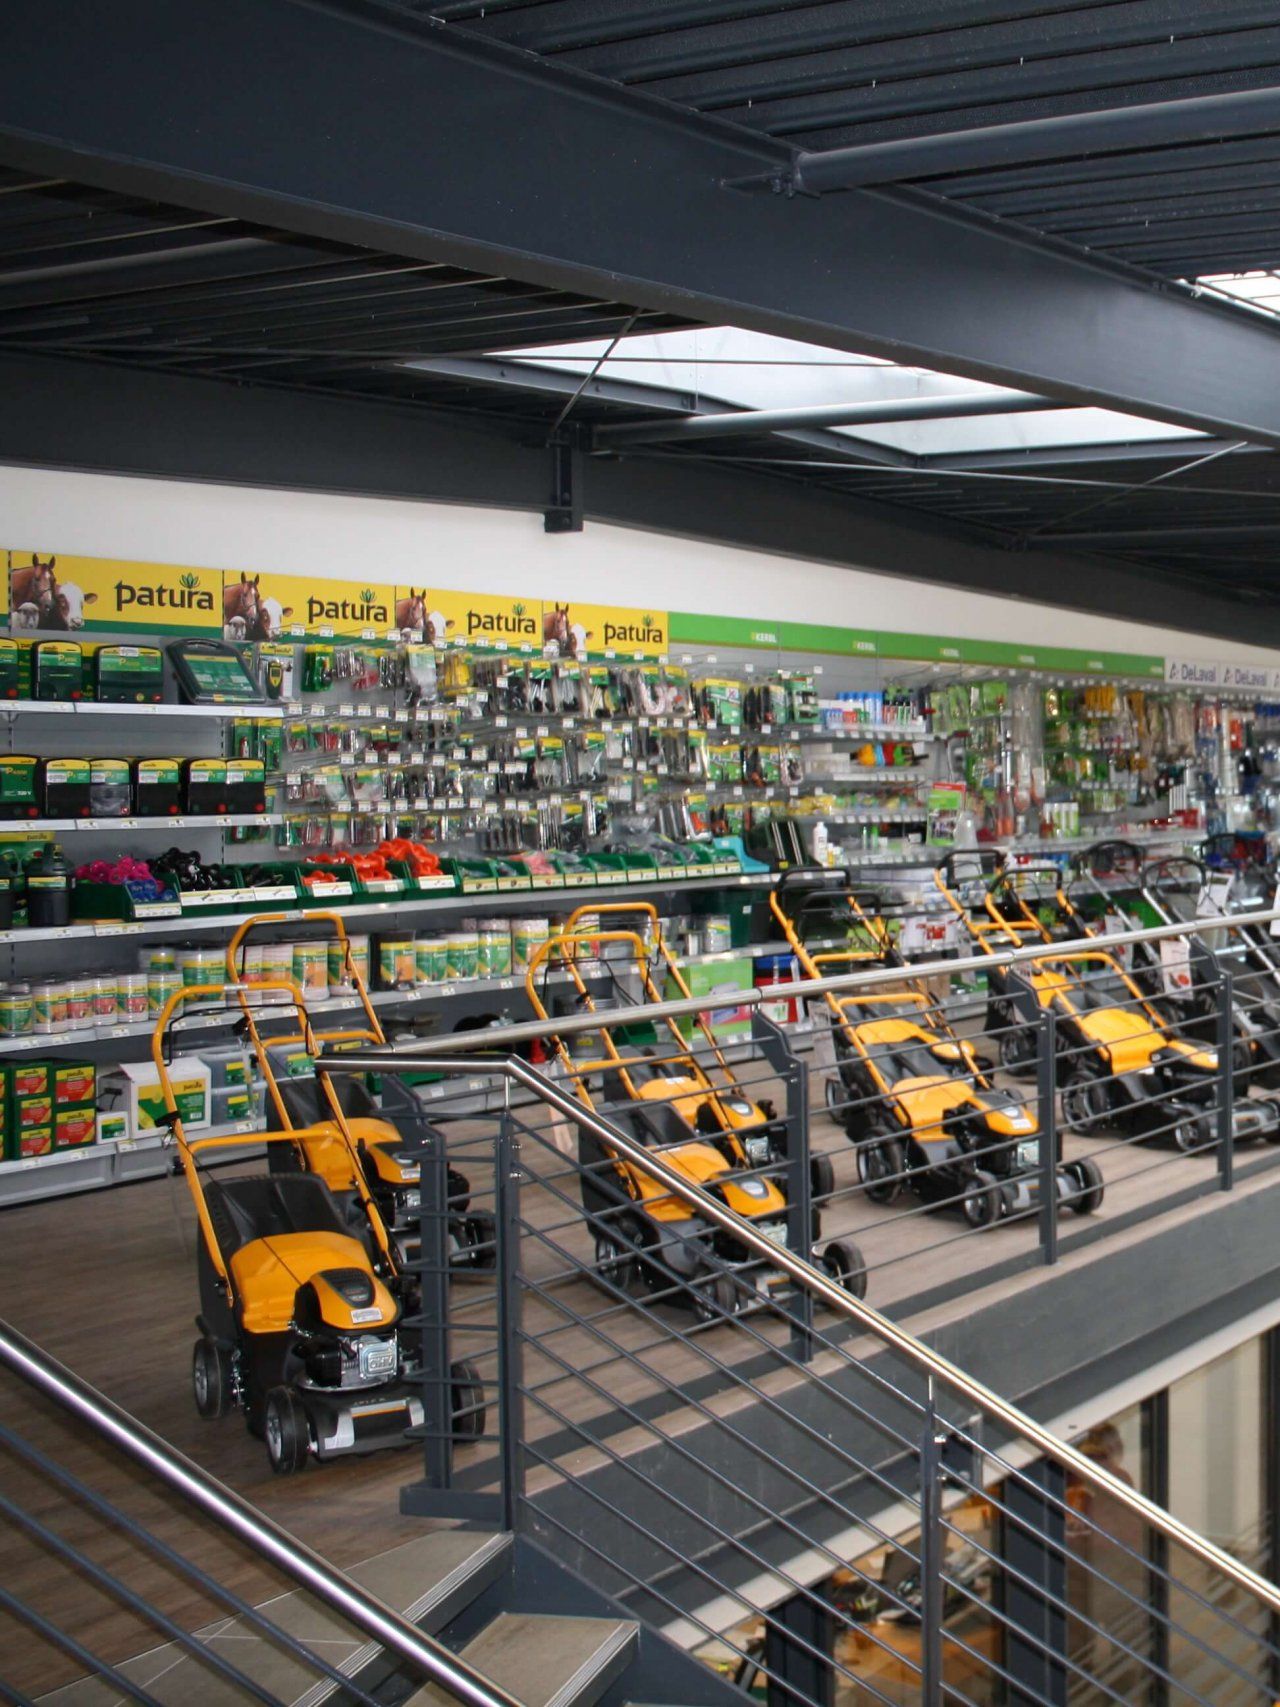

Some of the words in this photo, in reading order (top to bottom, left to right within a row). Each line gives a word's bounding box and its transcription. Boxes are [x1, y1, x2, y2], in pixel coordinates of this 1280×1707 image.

[114, 580, 214, 611] patura
[307, 595, 388, 624] patura
[466, 609, 536, 635] patura
[603, 622, 663, 645] patura
[1181, 663, 1217, 682] DeLaval
[1234, 667, 1267, 686] DeLaval
